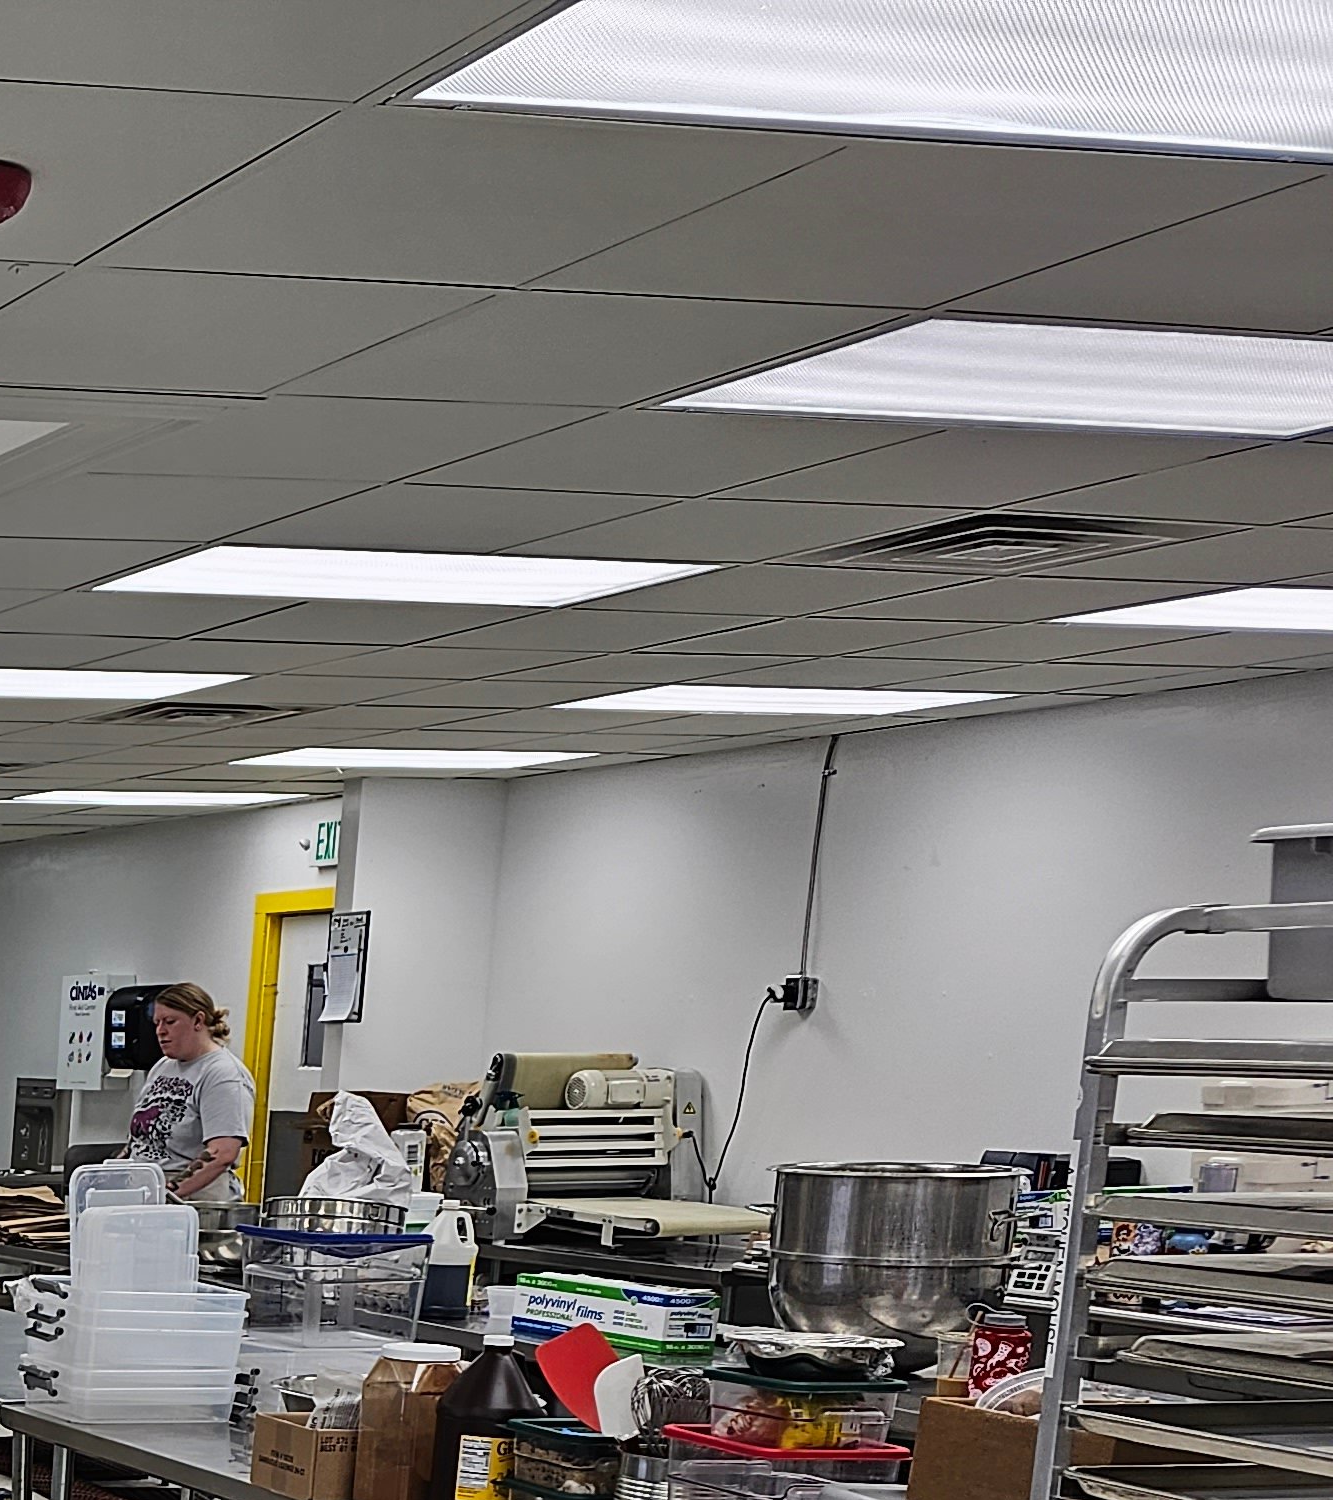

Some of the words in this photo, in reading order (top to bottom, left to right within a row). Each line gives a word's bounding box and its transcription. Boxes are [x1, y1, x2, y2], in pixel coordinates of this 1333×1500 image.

[315, 821, 342, 861] EXI
[525, 1307, 574, 1322] PROFESSIONAL
[527, 1293, 578, 1313] polyvinyl
[575, 1305, 606, 1321] films
